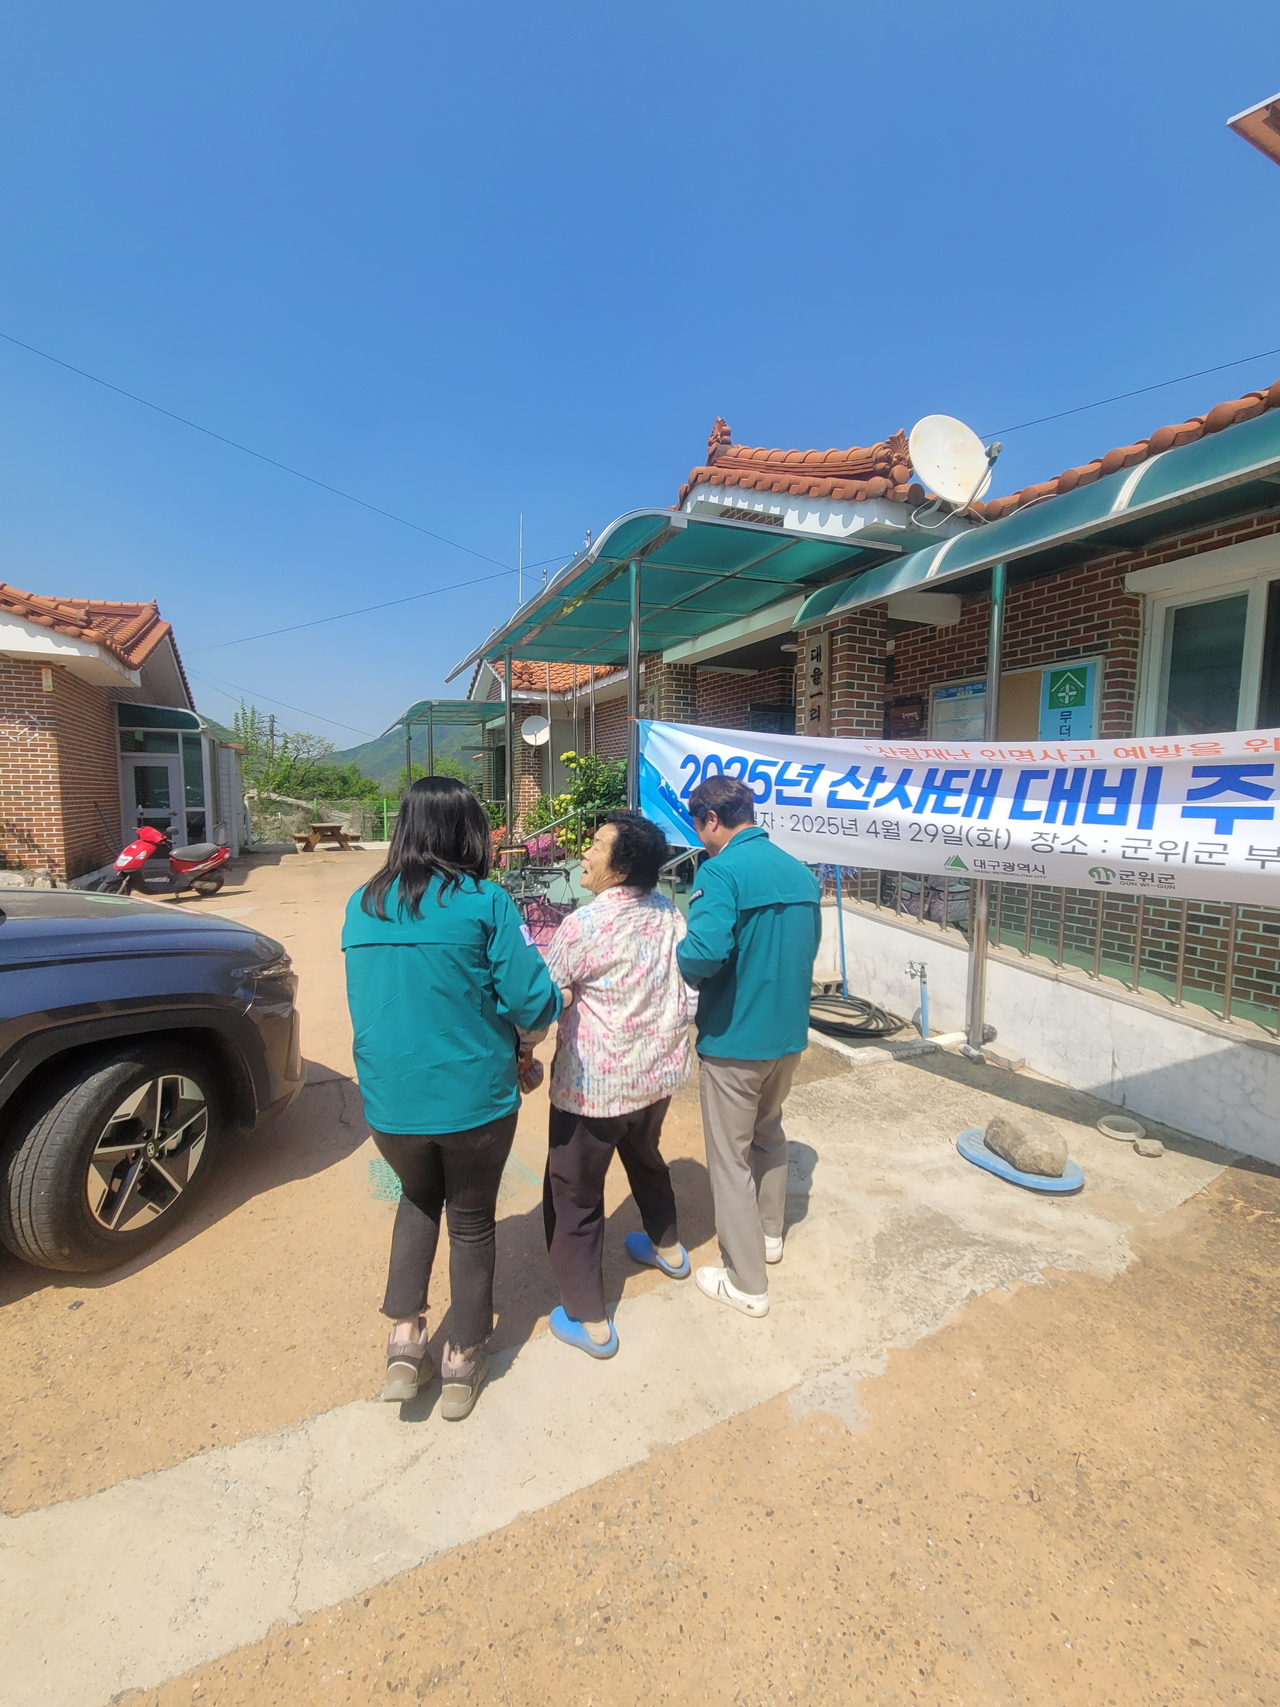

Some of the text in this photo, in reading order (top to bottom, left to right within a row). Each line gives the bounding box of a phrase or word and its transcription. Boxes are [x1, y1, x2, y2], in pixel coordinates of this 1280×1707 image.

[1060, 711, 1072, 740] 무더
[980, 748, 1102, 763] 인명사고
[1113, 742, 1225, 760] 예방을
[827, 765, 1003, 820] 산사태
[1008, 766, 1163, 830] 대비
[1180, 763, 1275, 835] 주
[790, 814, 859, 837] 2025년
[866, 819, 901, 840] 4월
[908, 822, 1011, 850] 29일(화)
[1031, 832, 1088, 855] 장소
[1121, 837, 1229, 866] 군위군
[1245, 845, 1280, 869] 부
[973, 859, 1046, 875] 대구광역시
[1119, 870, 1175, 885] 군위군
